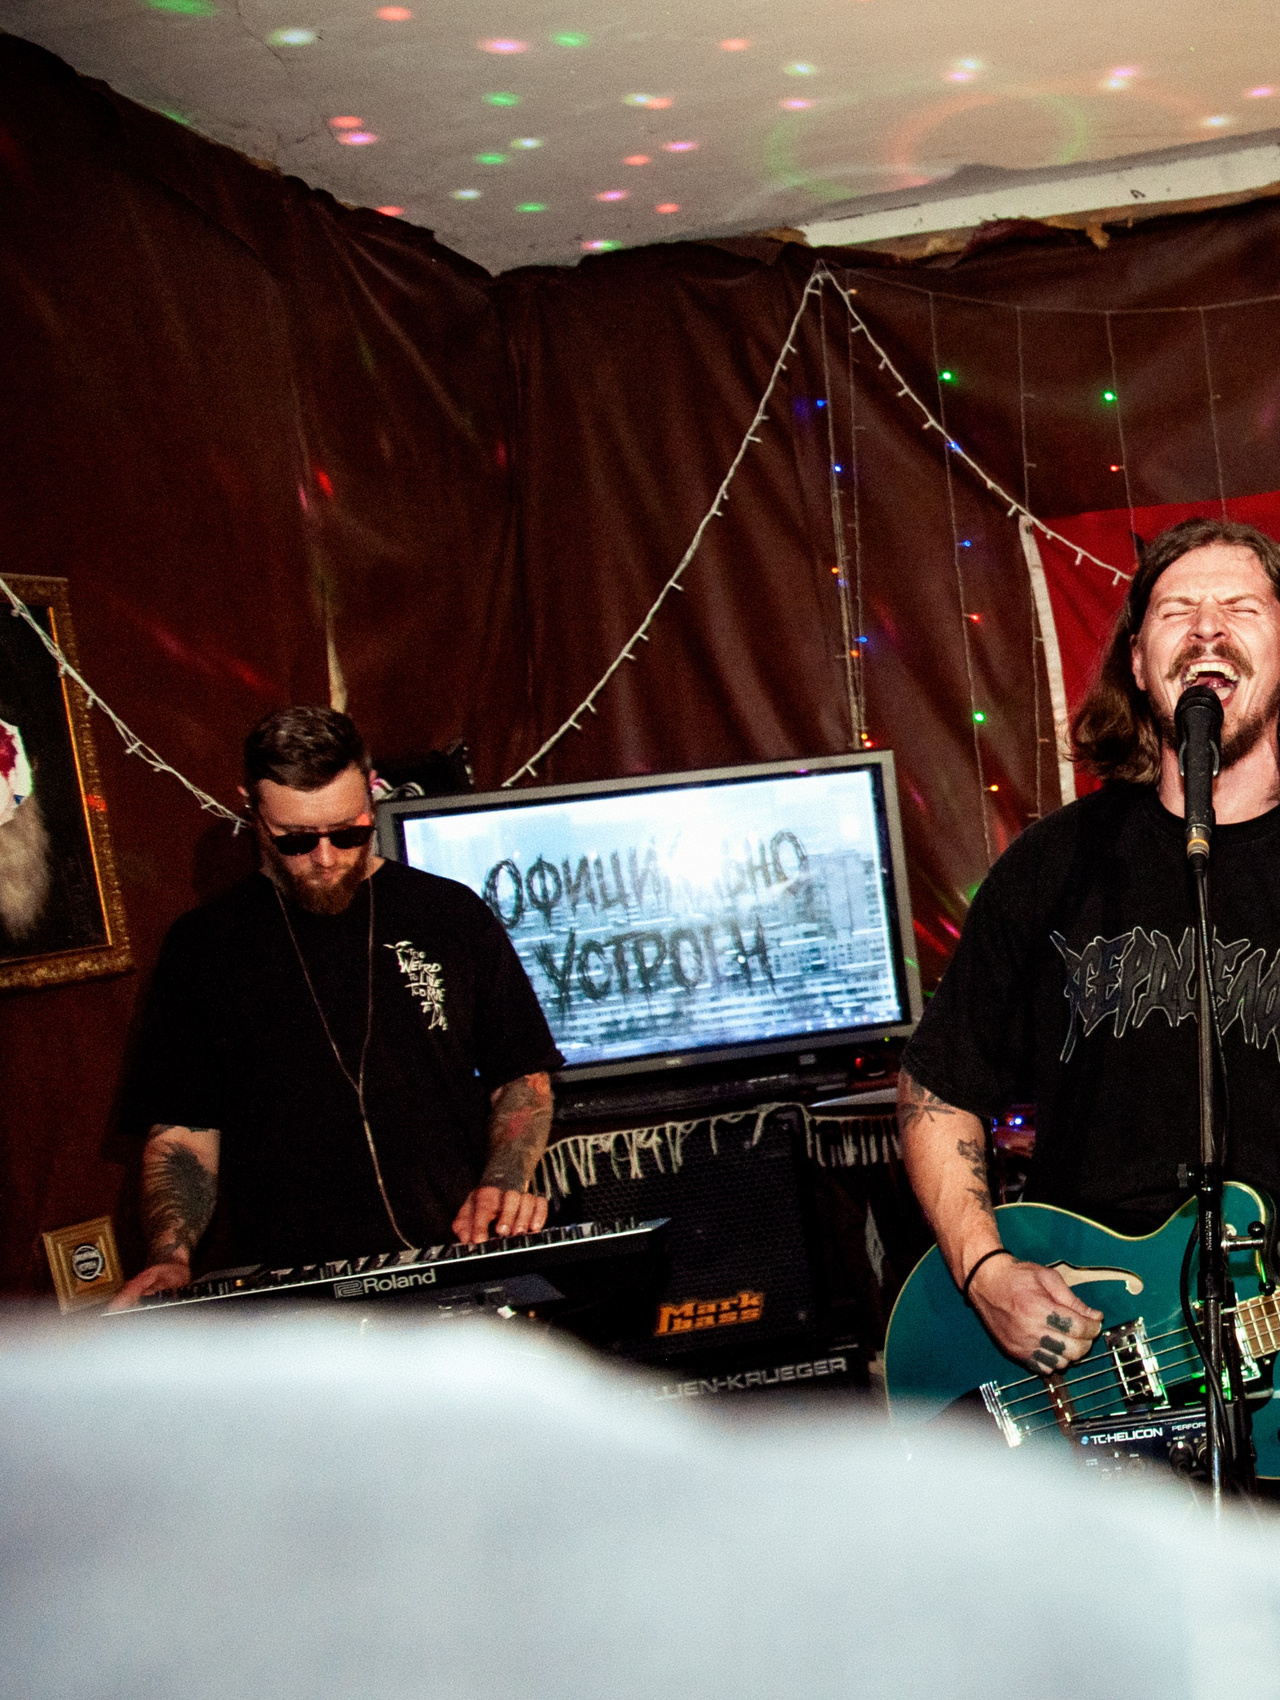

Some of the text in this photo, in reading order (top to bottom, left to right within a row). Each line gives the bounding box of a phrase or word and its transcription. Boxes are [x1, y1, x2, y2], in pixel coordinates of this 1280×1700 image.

[482, 830, 809, 929] ОФИЦИЬНО
[398, 957, 442, 976] WEIRD
[363, 1268, 437, 1294] Roland
[661, 1356, 848, 1397] LIEN-KRUEGER
